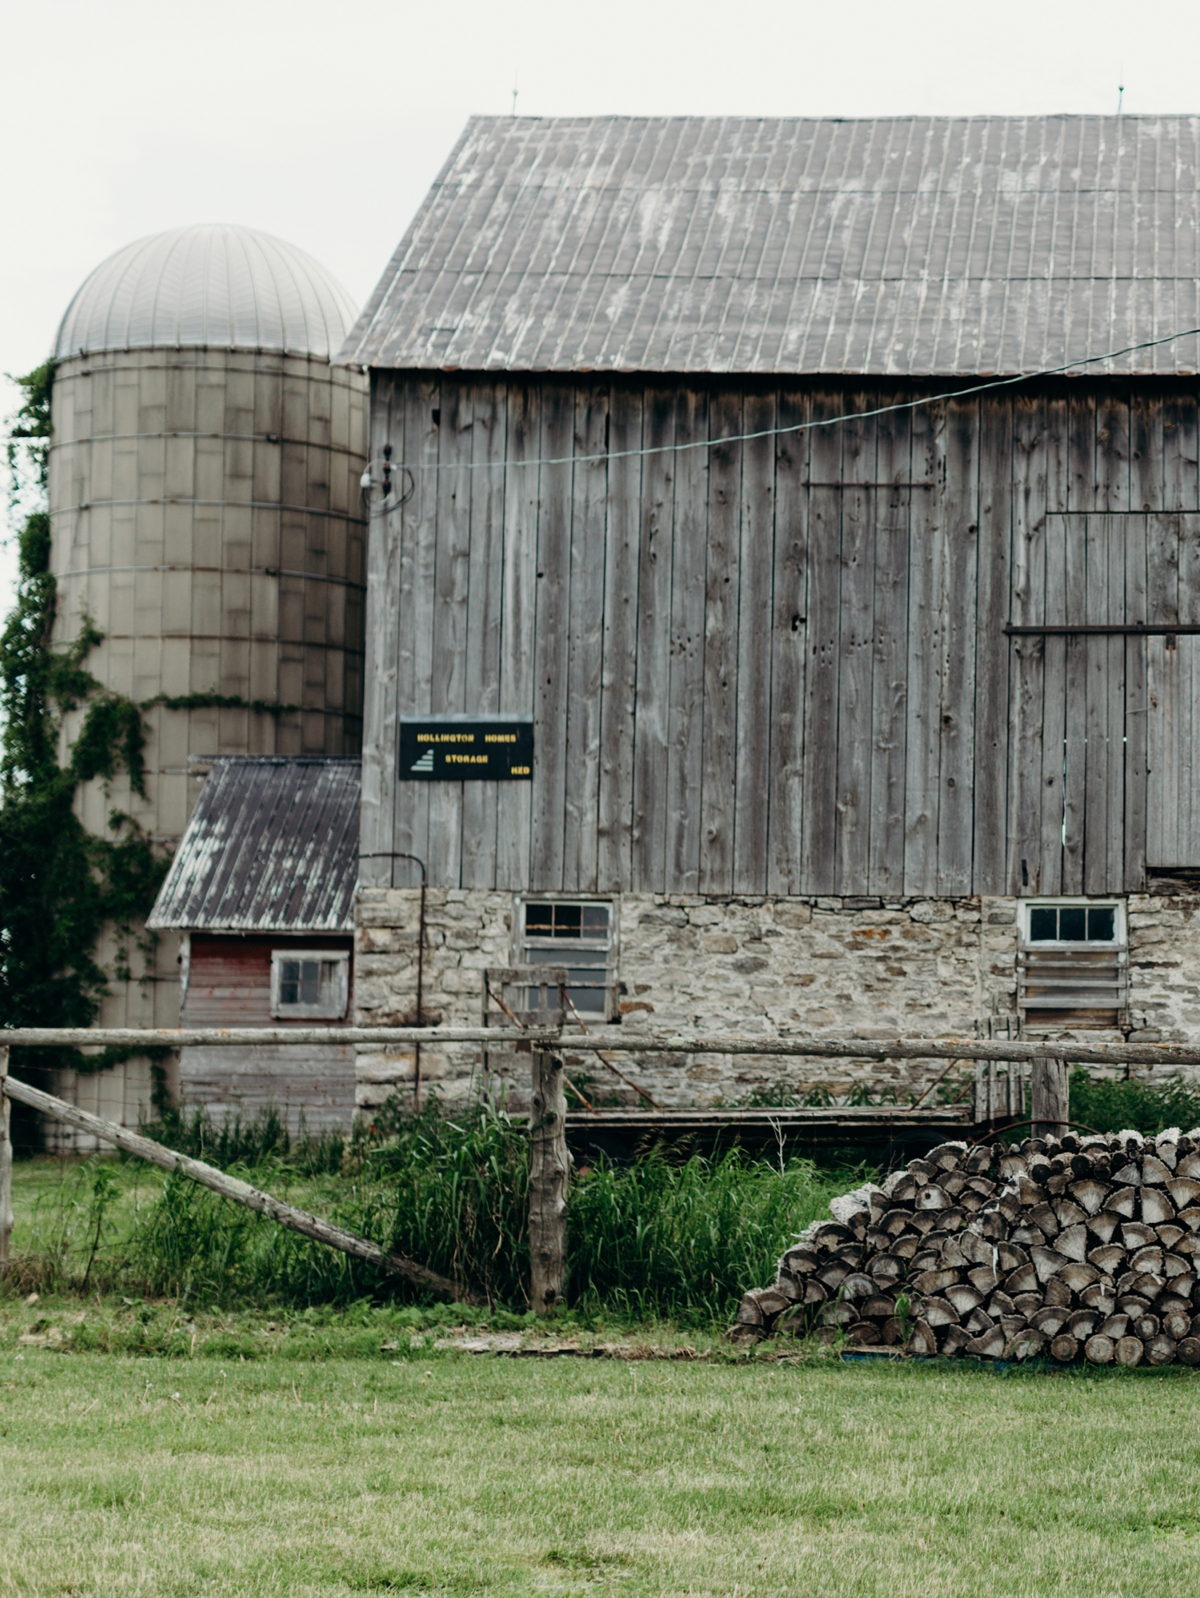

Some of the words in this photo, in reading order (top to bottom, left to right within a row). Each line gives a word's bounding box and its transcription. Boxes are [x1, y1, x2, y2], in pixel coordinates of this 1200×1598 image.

[417, 733, 475, 743] HOLLINGTON
[484, 734, 517, 743] HOMES
[445, 754, 489, 764] STORAGE
